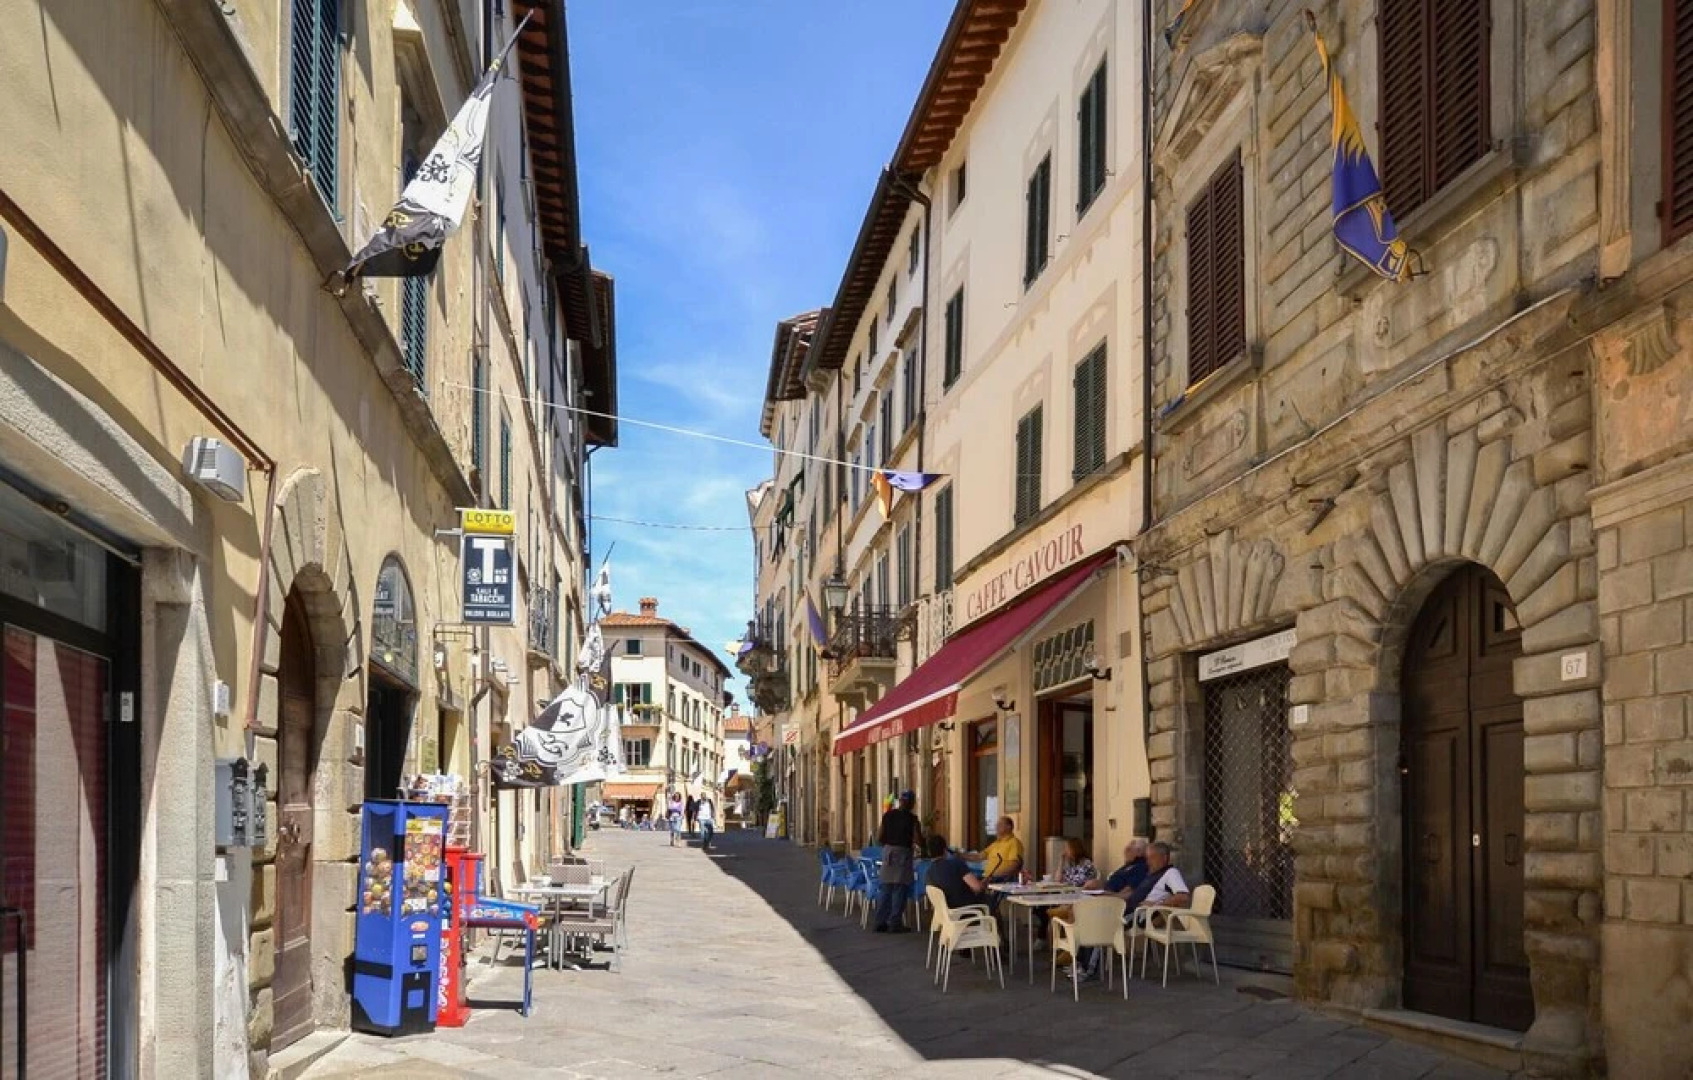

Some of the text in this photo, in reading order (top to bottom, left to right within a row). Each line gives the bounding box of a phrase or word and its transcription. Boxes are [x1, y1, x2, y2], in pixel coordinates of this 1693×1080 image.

[466, 512, 512, 525] LOTTO
[472, 538, 505, 584] T
[1015, 523, 1084, 590] CAVOUR
[1565, 658, 1582, 674] 67
